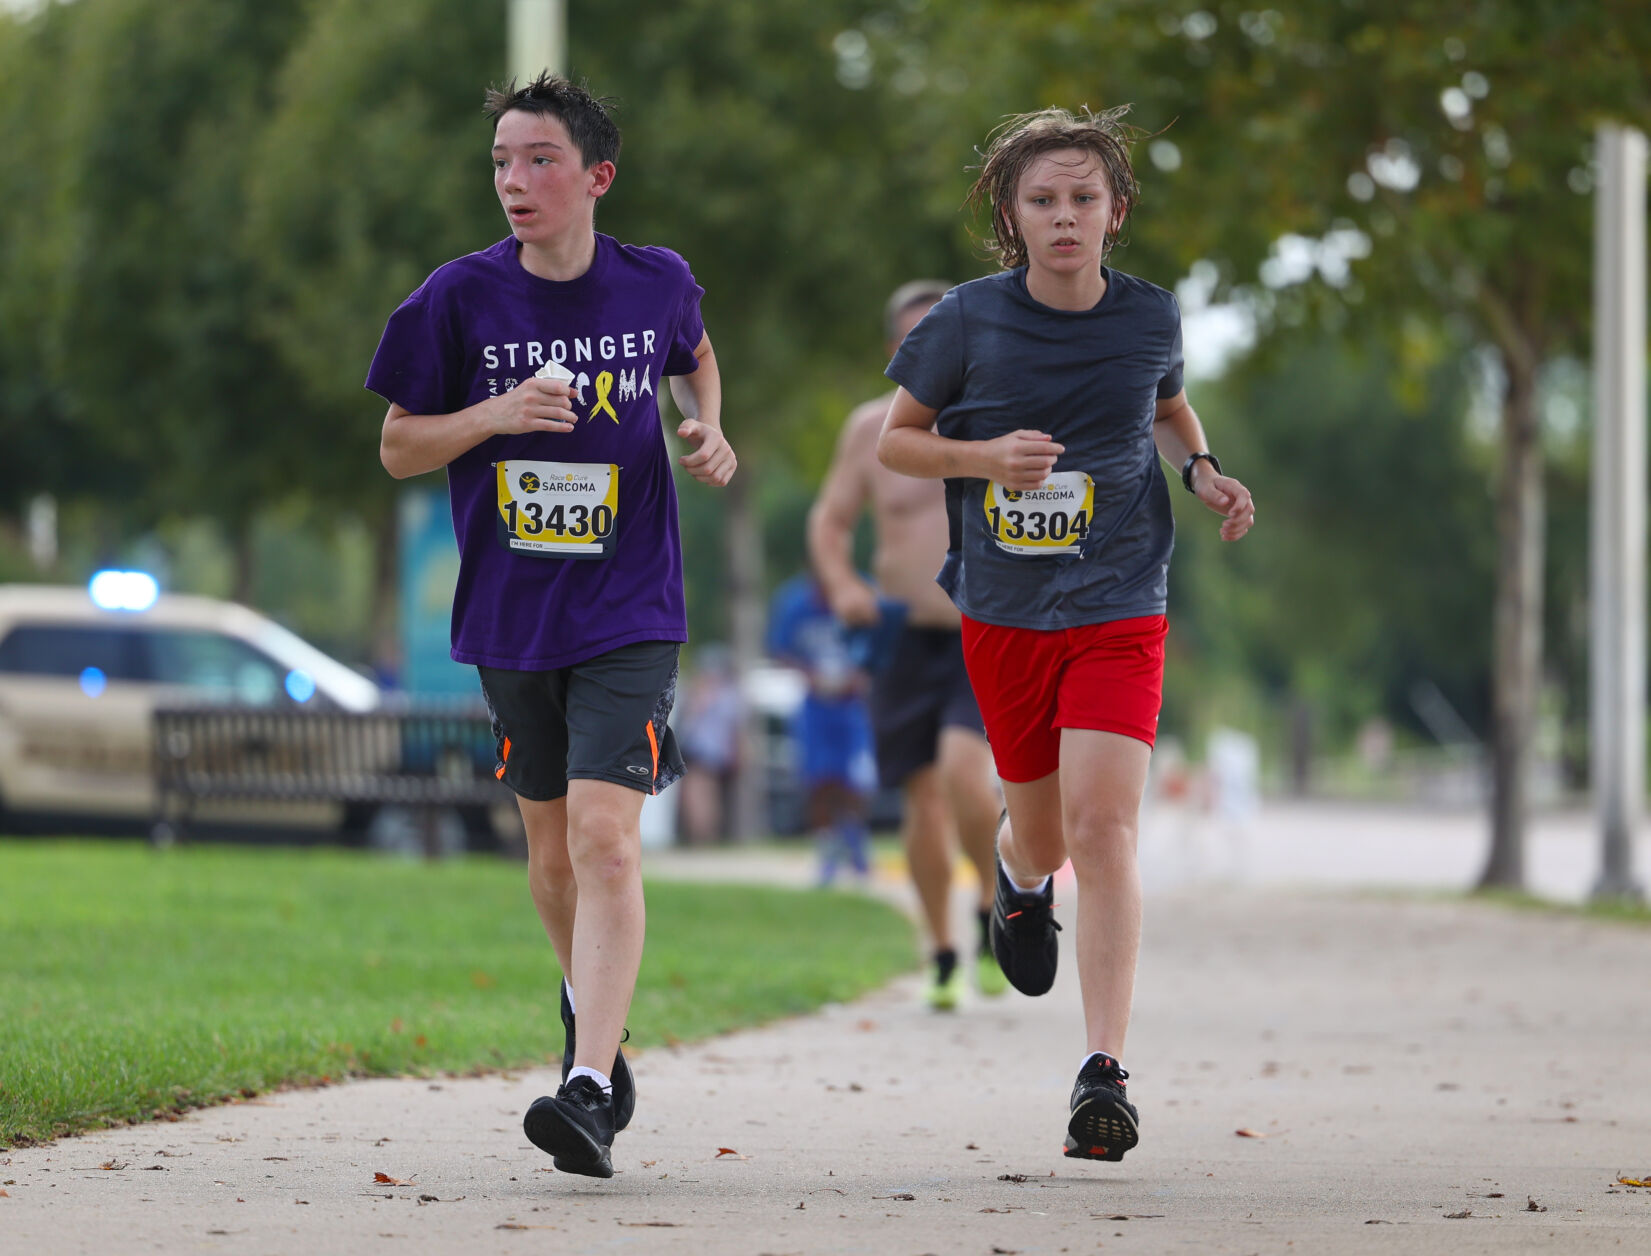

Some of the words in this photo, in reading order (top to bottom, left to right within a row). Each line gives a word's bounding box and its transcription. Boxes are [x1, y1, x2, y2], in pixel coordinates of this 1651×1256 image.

[483, 329, 656, 370] STRONGER
[542, 481, 596, 492] SARCOMA
[1024, 490, 1075, 500] SARCOMA
[504, 500, 613, 538] 13430
[989, 506, 1088, 539] 13304
